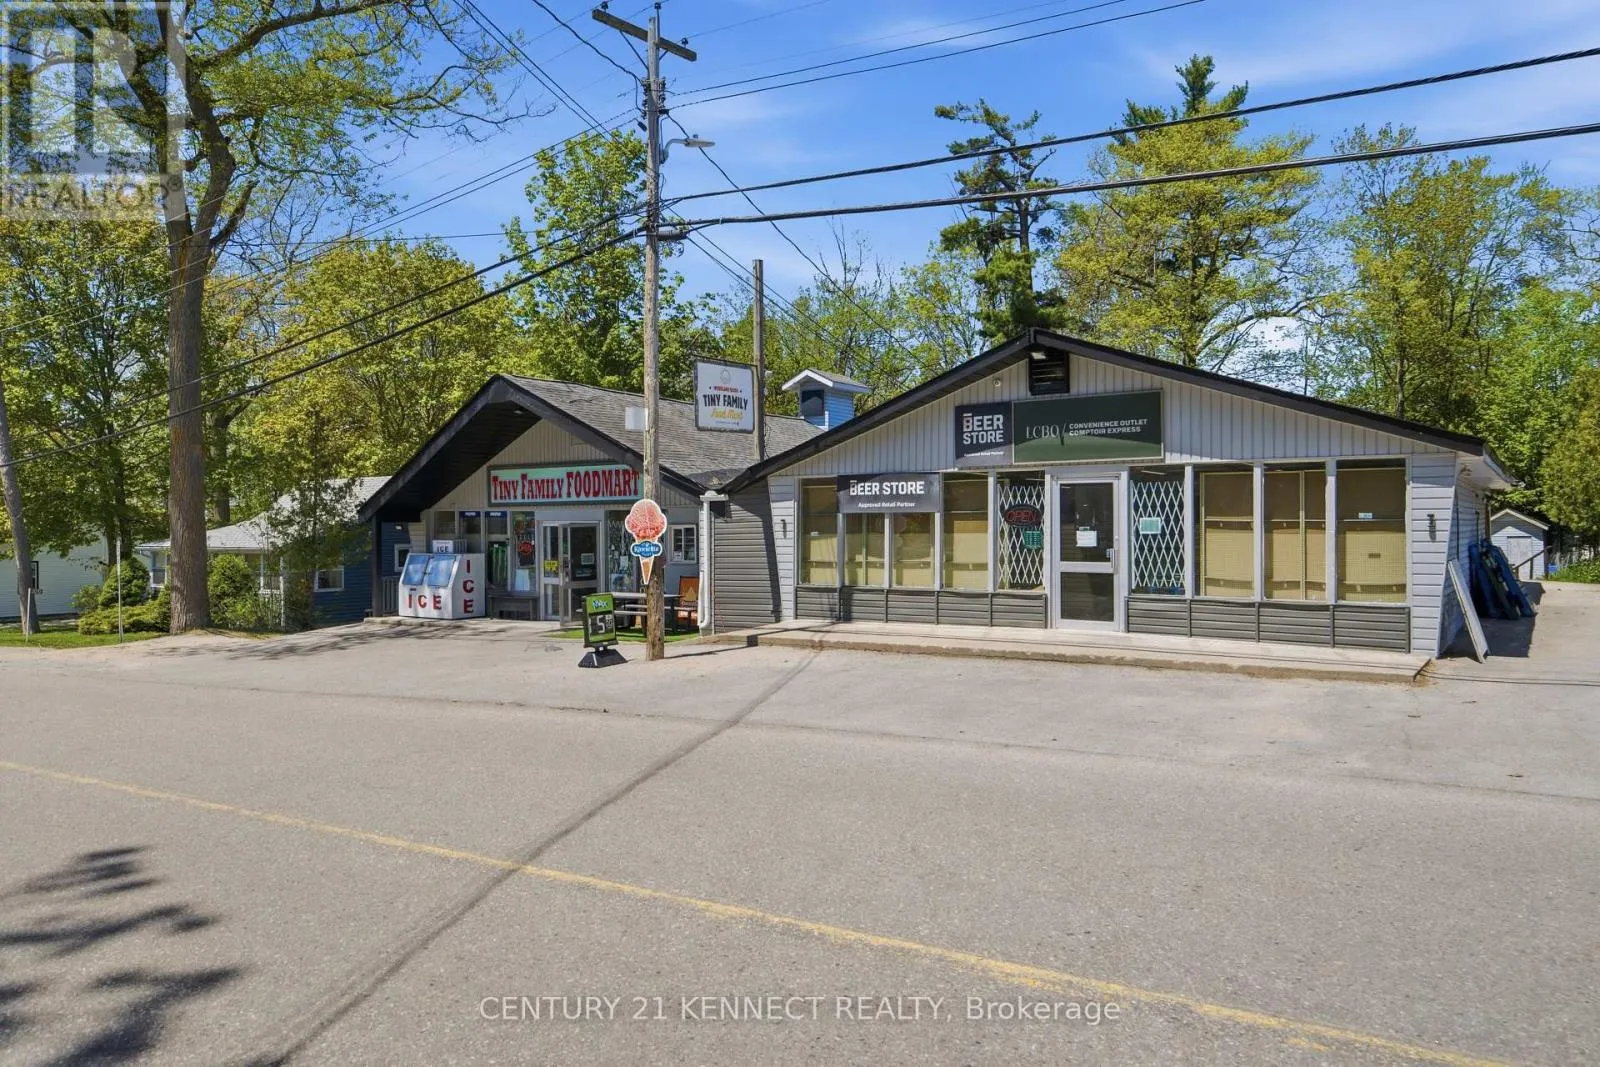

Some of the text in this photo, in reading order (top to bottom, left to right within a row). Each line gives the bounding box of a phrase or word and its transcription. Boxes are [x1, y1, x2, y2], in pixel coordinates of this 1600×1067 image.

[702, 394, 748, 411] TINY FAMILY
[963, 413, 1004, 431] BEER
[1069, 418, 1148, 430] CONVENIENCE OUTLET
[963, 430, 1004, 445] STORE
[1069, 426, 1142, 437] COMPTOIR EXPRESS
[566, 468, 640, 498] FOODMART
[849, 480, 925, 496] BEER STORE
[436, 544, 449, 553] ICE
[408, 594, 442, 610] ICE
